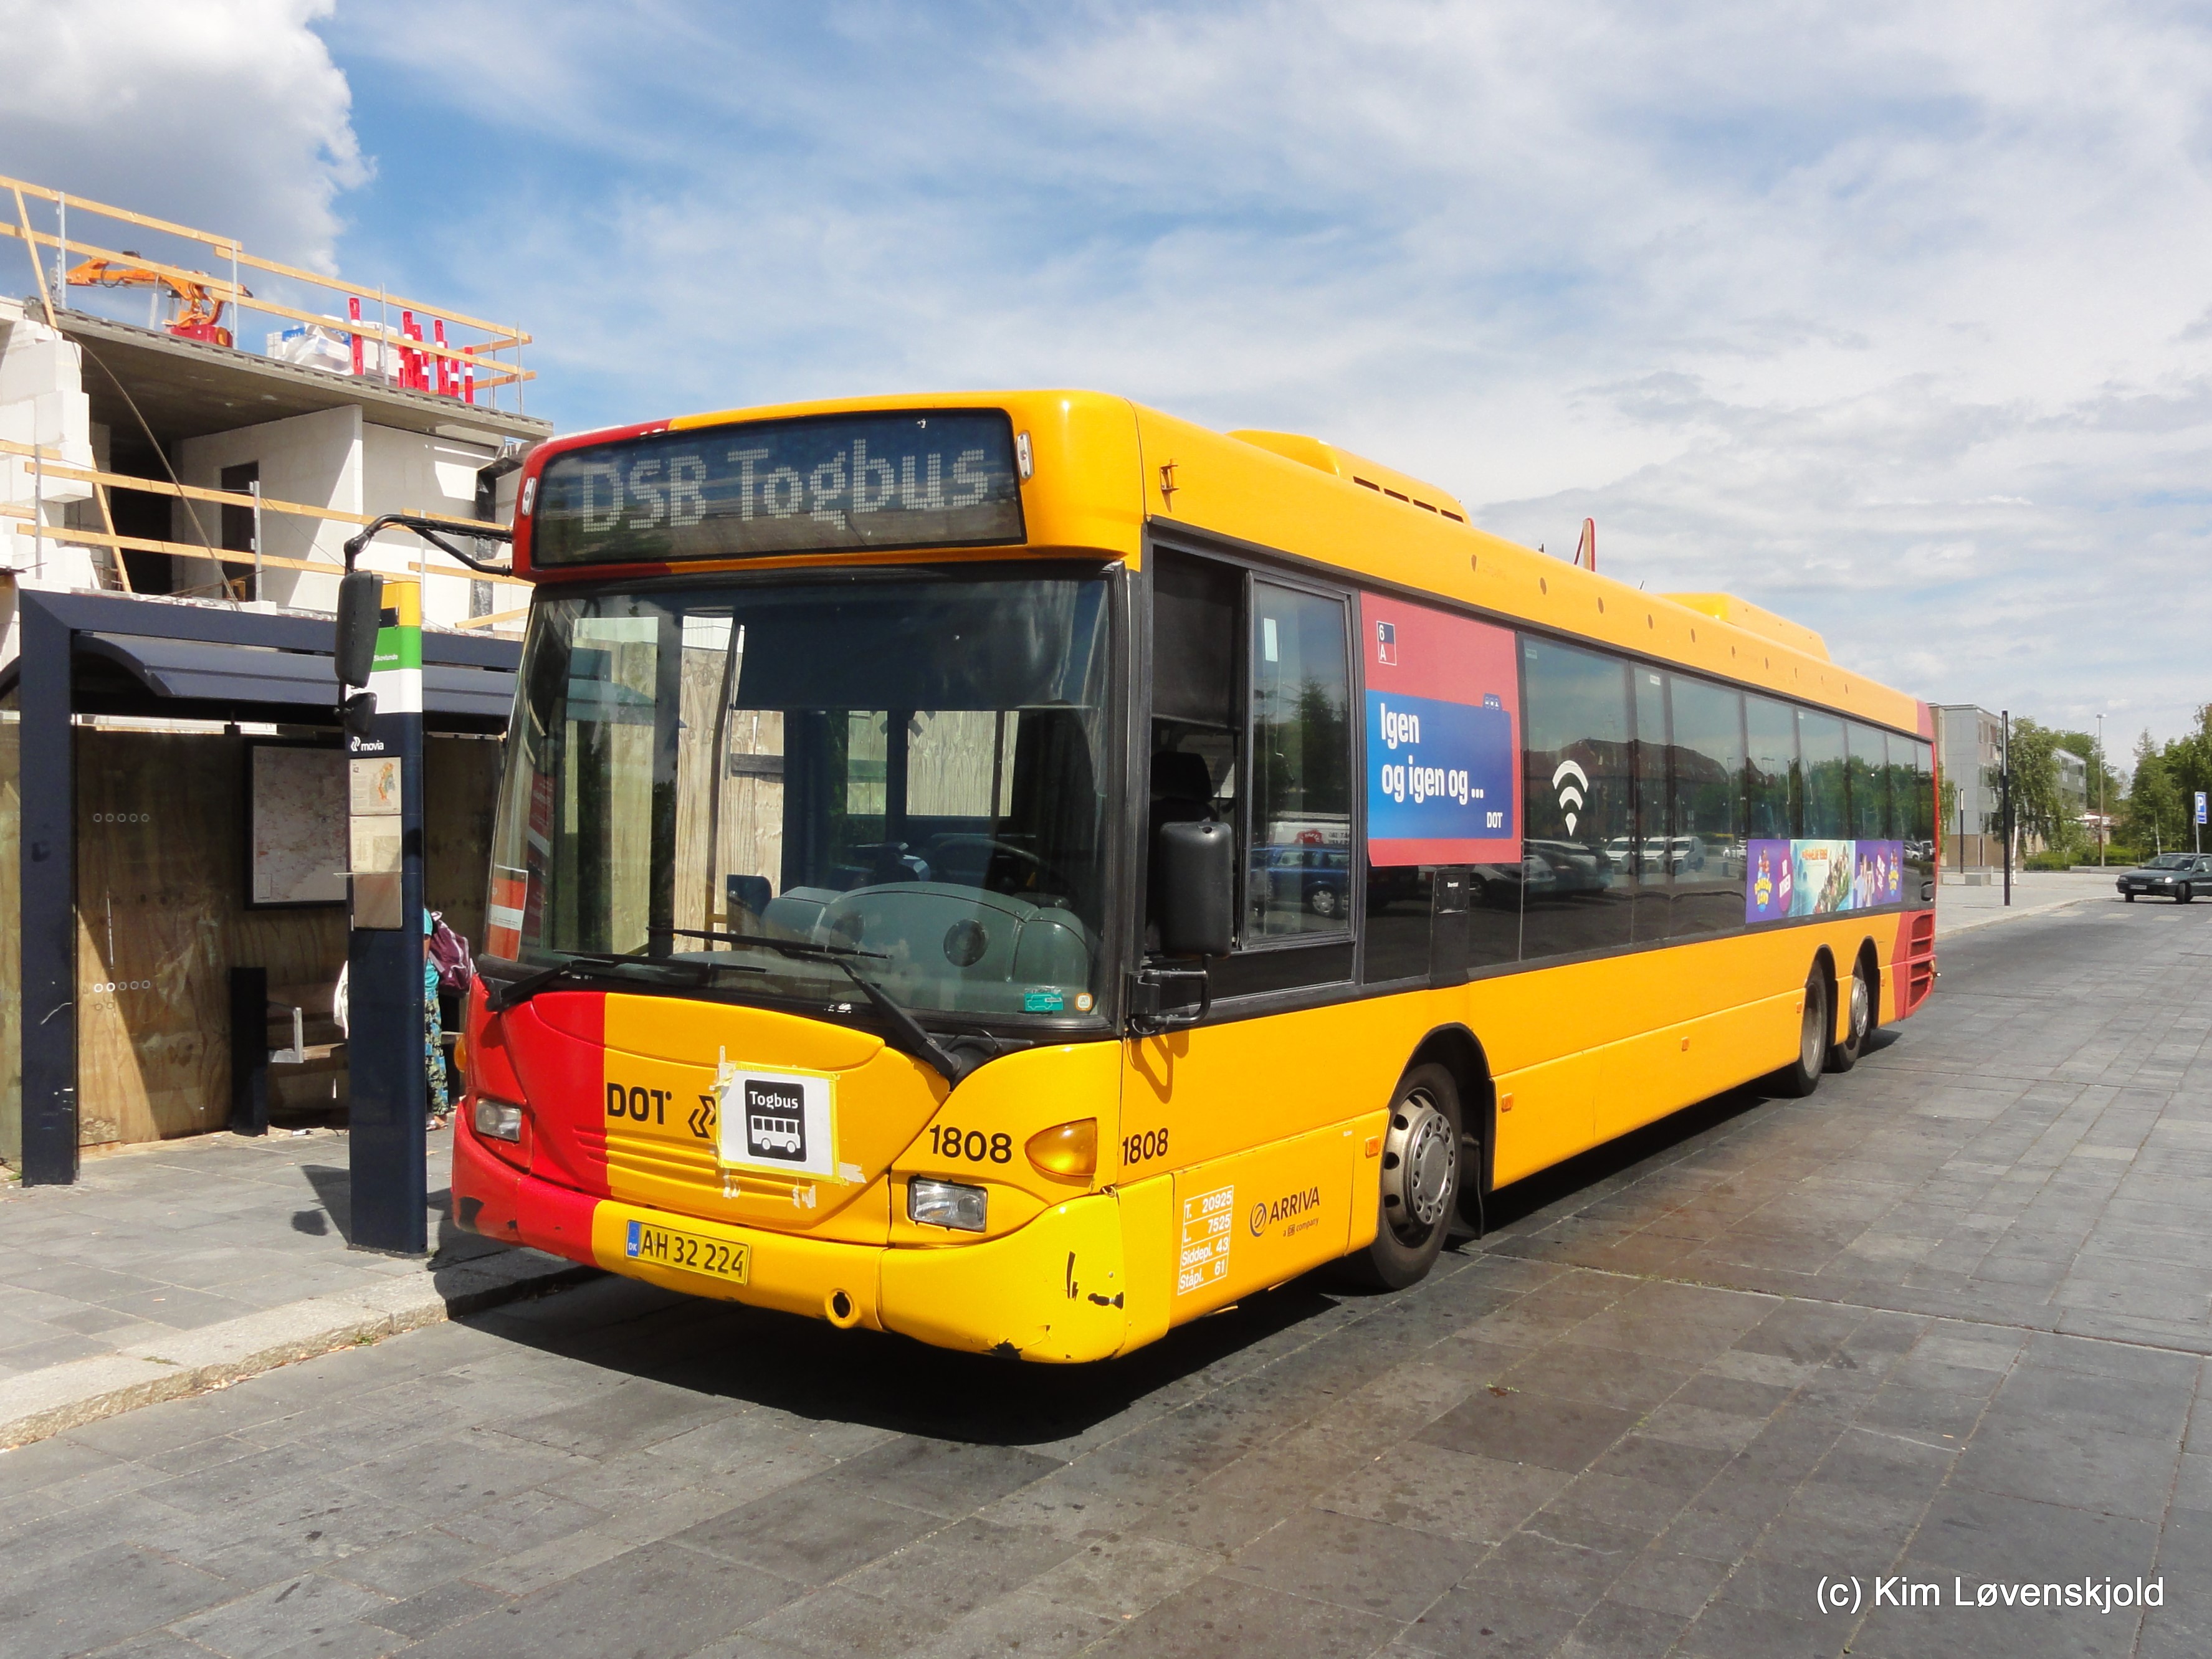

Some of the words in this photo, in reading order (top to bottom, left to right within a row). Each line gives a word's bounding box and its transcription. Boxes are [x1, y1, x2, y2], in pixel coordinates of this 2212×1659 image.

[583, 455, 707, 533] DSB
[728, 439, 988, 531] Togbus
[1379, 625, 1385, 640] 6
[1380, 644, 1386, 661] A
[1380, 703, 1419, 749] Igen
[361, 739, 384, 751] movia
[1381, 764, 1404, 803] og
[1408, 756, 1444, 804] igen
[1487, 812, 1503, 829] DOT
[607, 1082, 672, 1125] DOT
[749, 1091, 798, 1110] Togbus
[929, 1124, 1012, 1164] 1808
[1122, 1127, 1169, 1166] 1808
[1202, 1190, 1232, 1214] 20925
[1269, 1186, 1320, 1225] ARRIVA
[1208, 1214, 1230, 1234] 7525
[1296, 1217, 1319, 1232] company
[628, 1242, 637, 1252] DK
[640, 1229, 668, 1260] AH
[674, 1237, 698, 1267] 32
[704, 1244, 744, 1277] 224
[1181, 1243, 1213, 1267] Siddepl.
[1216, 1236, 1229, 1253] 43
[1180, 1267, 1204, 1290] Ståpl.
[1214, 1260, 1225, 1276] 61
